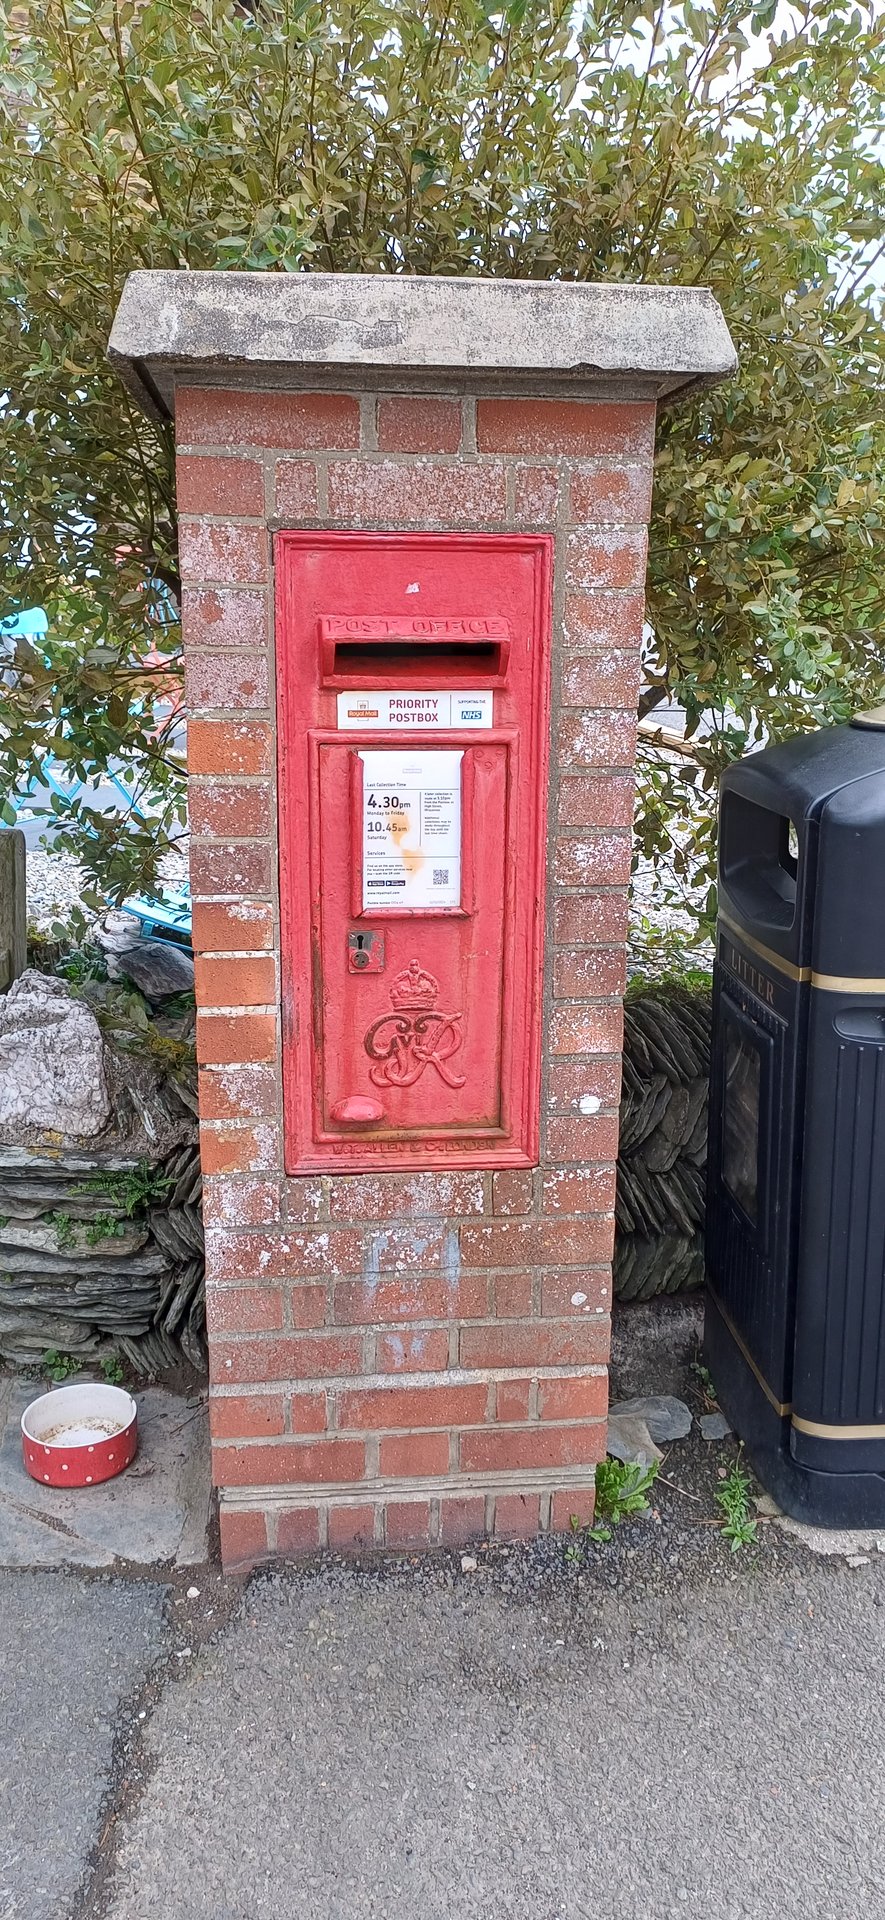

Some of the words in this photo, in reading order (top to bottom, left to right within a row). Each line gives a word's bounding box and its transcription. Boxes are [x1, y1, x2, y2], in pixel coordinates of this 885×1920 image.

[326, 618, 397, 633] POST
[412, 619, 504, 635] OFFICE
[389, 699, 439, 709] PRIORITY
[389, 713, 439, 723] POSTBOX
[462, 711, 481, 719] NHS
[367, 794, 411, 809] 4.30pm
[367, 821, 408, 832] 10.45am
[731, 948, 775, 1005] LITTER
